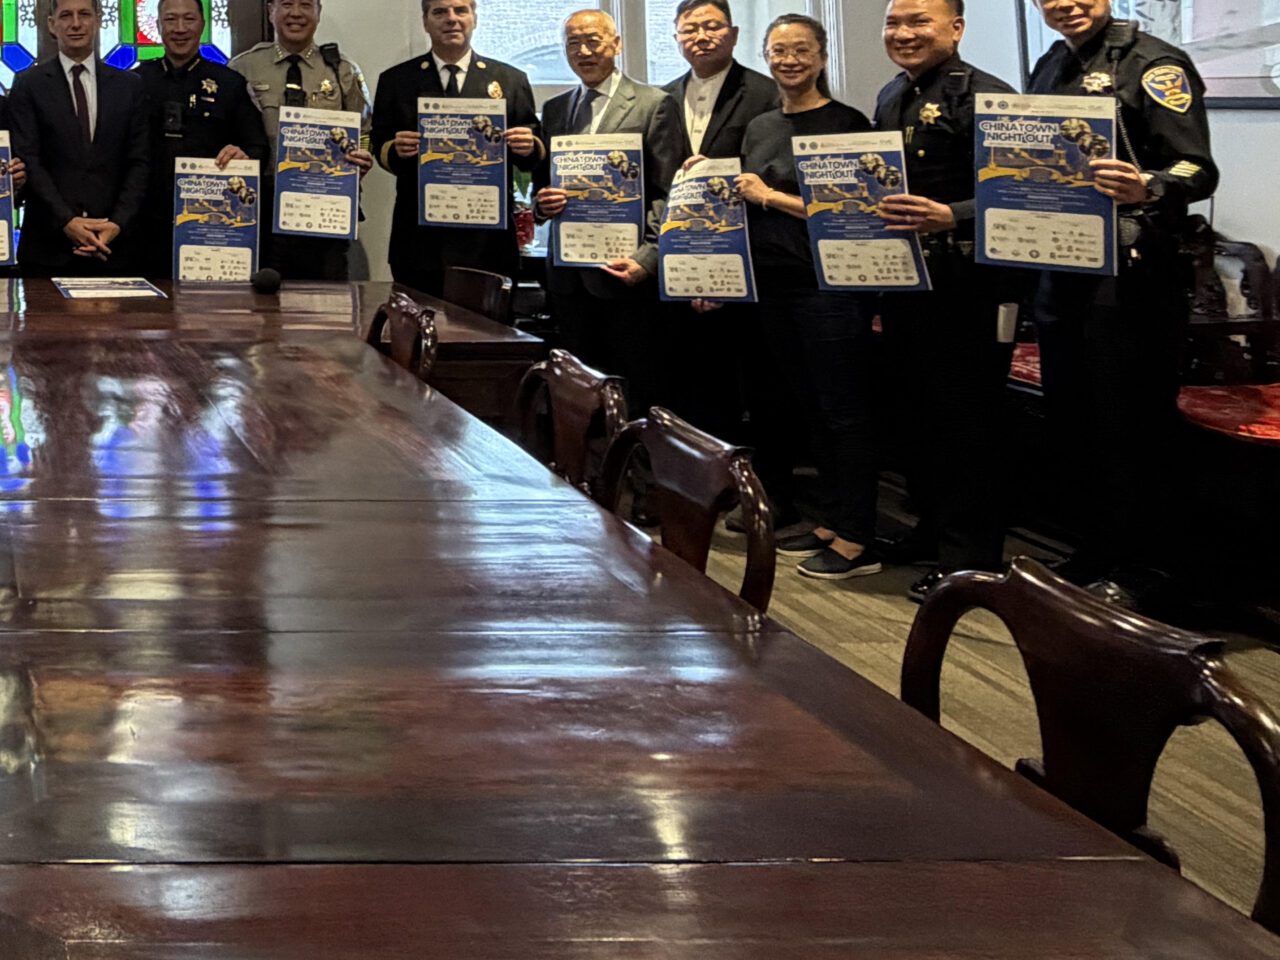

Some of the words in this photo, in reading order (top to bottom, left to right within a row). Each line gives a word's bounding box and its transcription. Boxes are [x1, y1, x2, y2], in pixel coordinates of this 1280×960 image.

[981, 121, 1058, 133] CHINATOWN
[986, 132, 1023, 142] NIGHT
[1025, 133, 1051, 143] OUT
[800, 160, 859, 170] CHINATOWN
[805, 170, 833, 179] NIGHT
[834, 170, 854, 179] OUT
